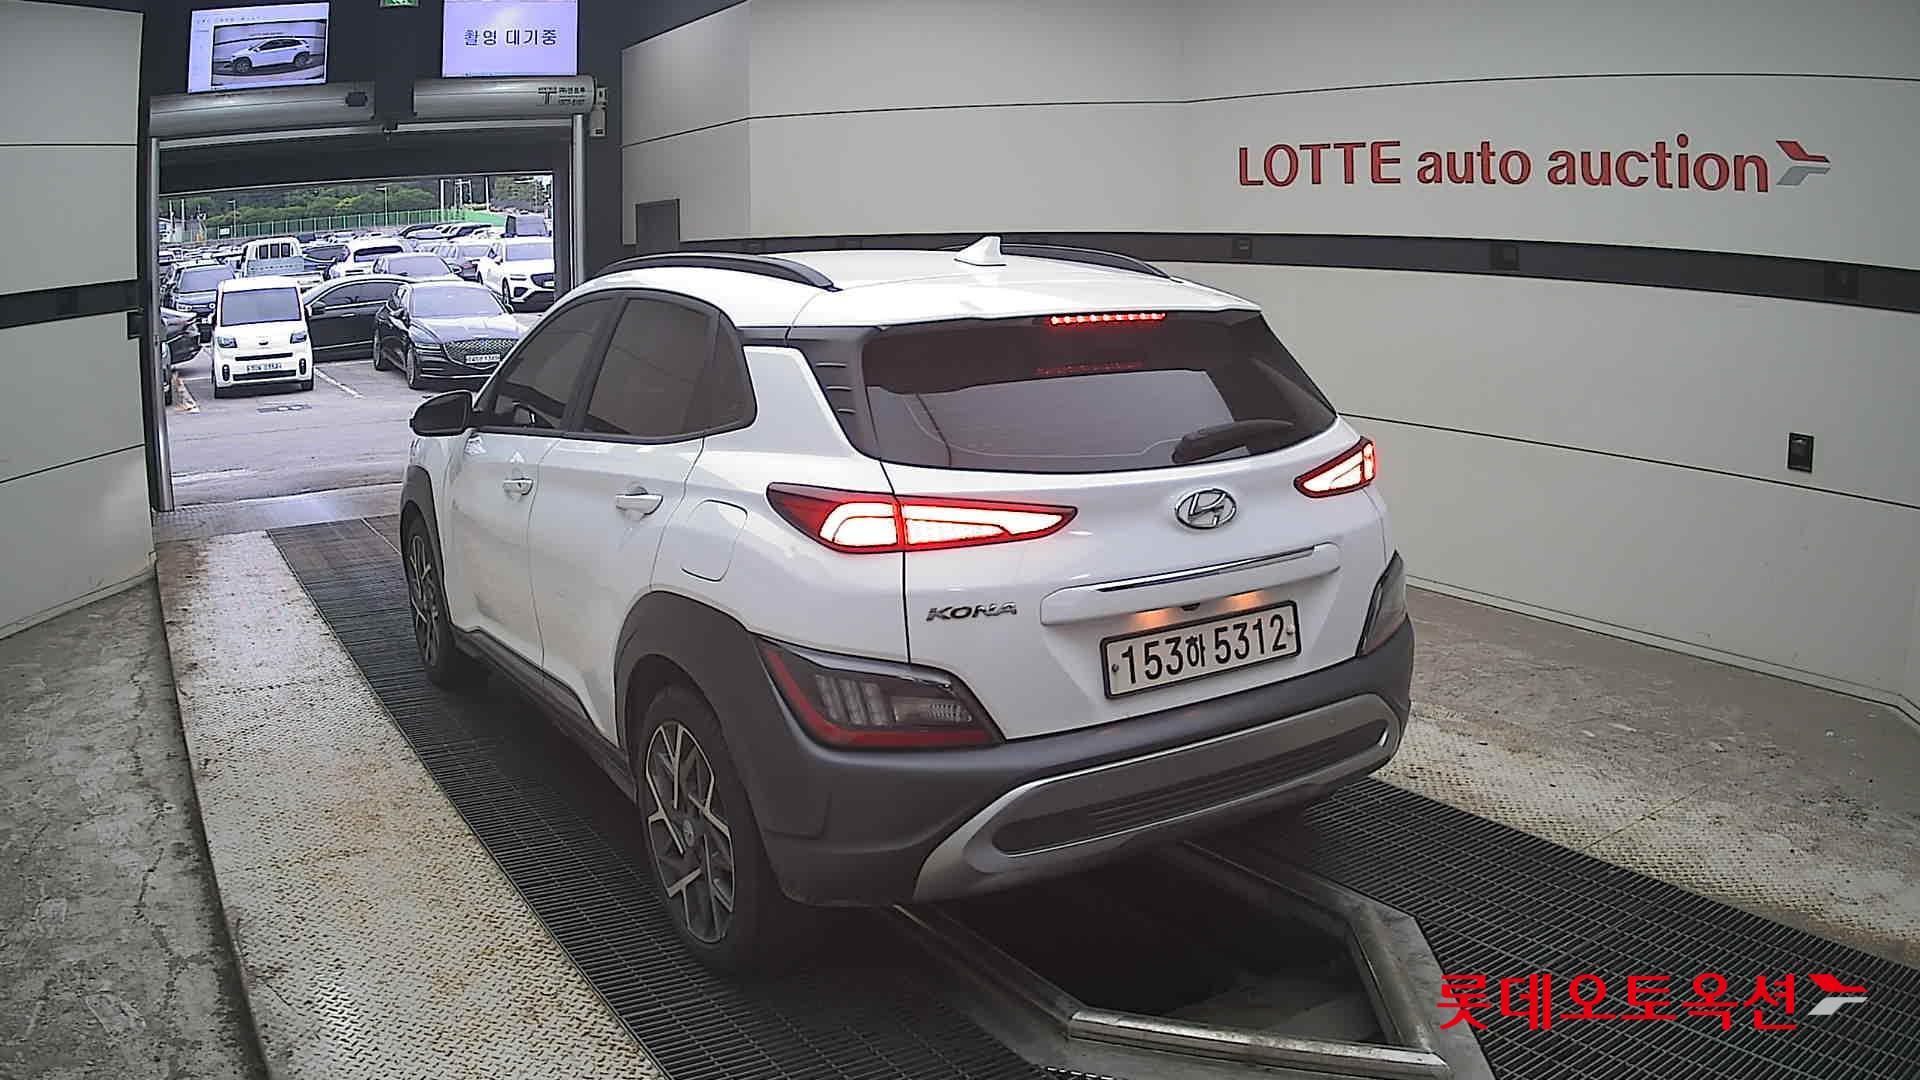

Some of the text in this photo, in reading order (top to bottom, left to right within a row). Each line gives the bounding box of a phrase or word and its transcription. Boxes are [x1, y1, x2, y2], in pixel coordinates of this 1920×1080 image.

[505, 28, 558, 46] 대기중
[1238, 134, 1770, 193] LOTTE auto auction
[926, 602, 1018, 622] KONA
[1213, 613, 1288, 665] 5312
